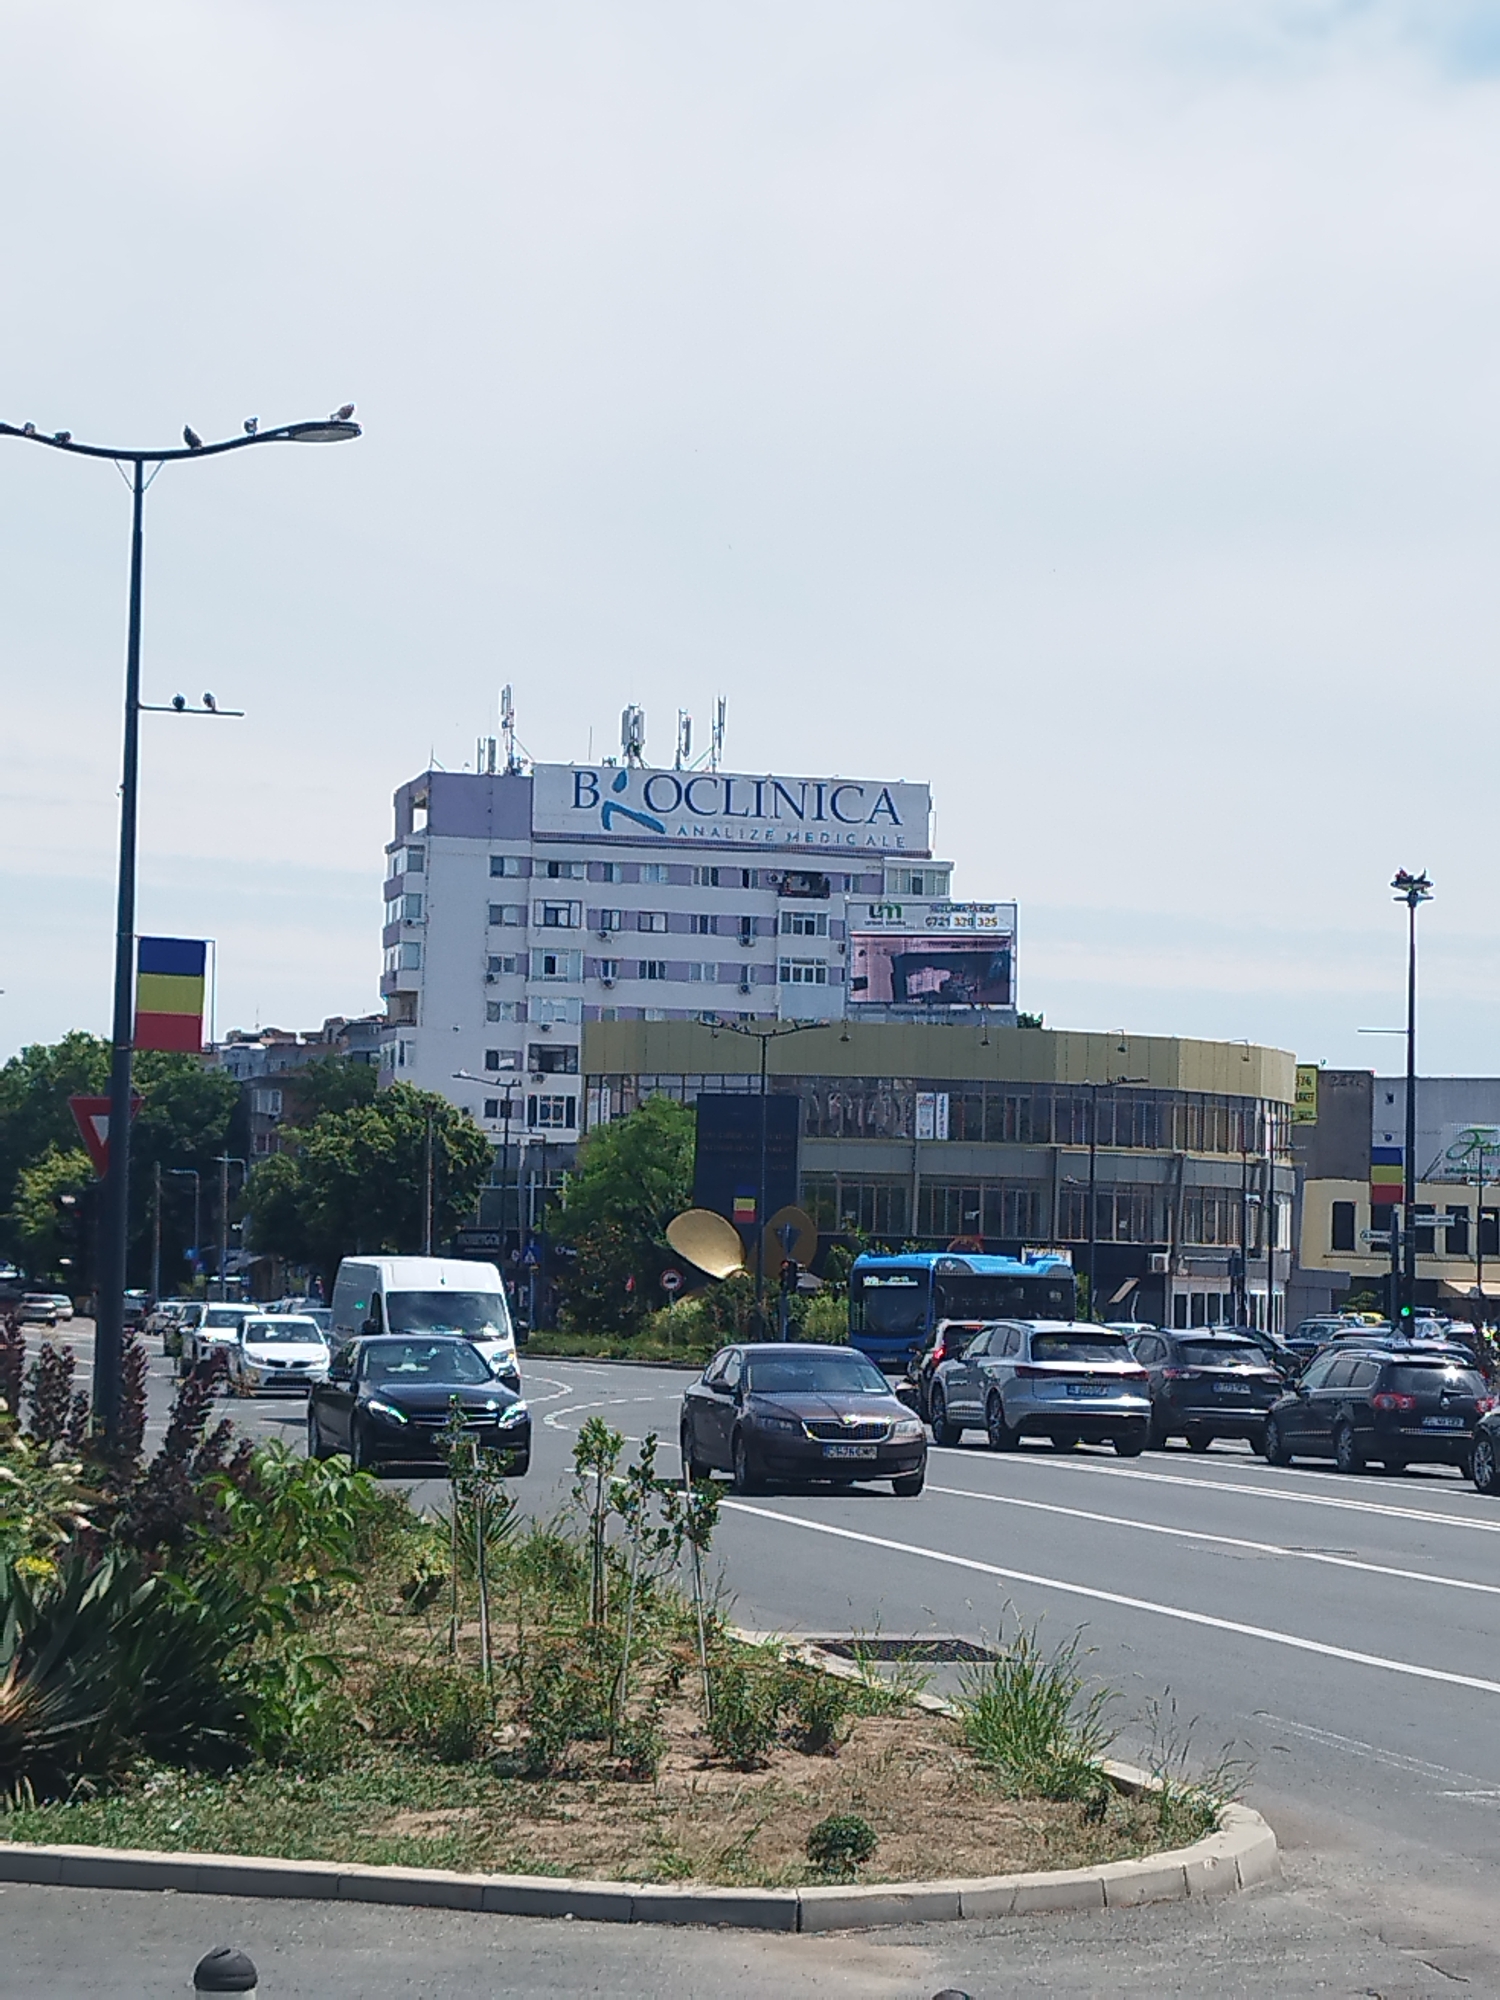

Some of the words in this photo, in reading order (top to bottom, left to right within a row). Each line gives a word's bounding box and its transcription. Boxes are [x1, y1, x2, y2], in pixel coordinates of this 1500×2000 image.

[571, 768, 903, 832] BIOCLINICA
[677, 825, 775, 841] ANALIZE
[786, 829, 906, 849] MEDICALE
